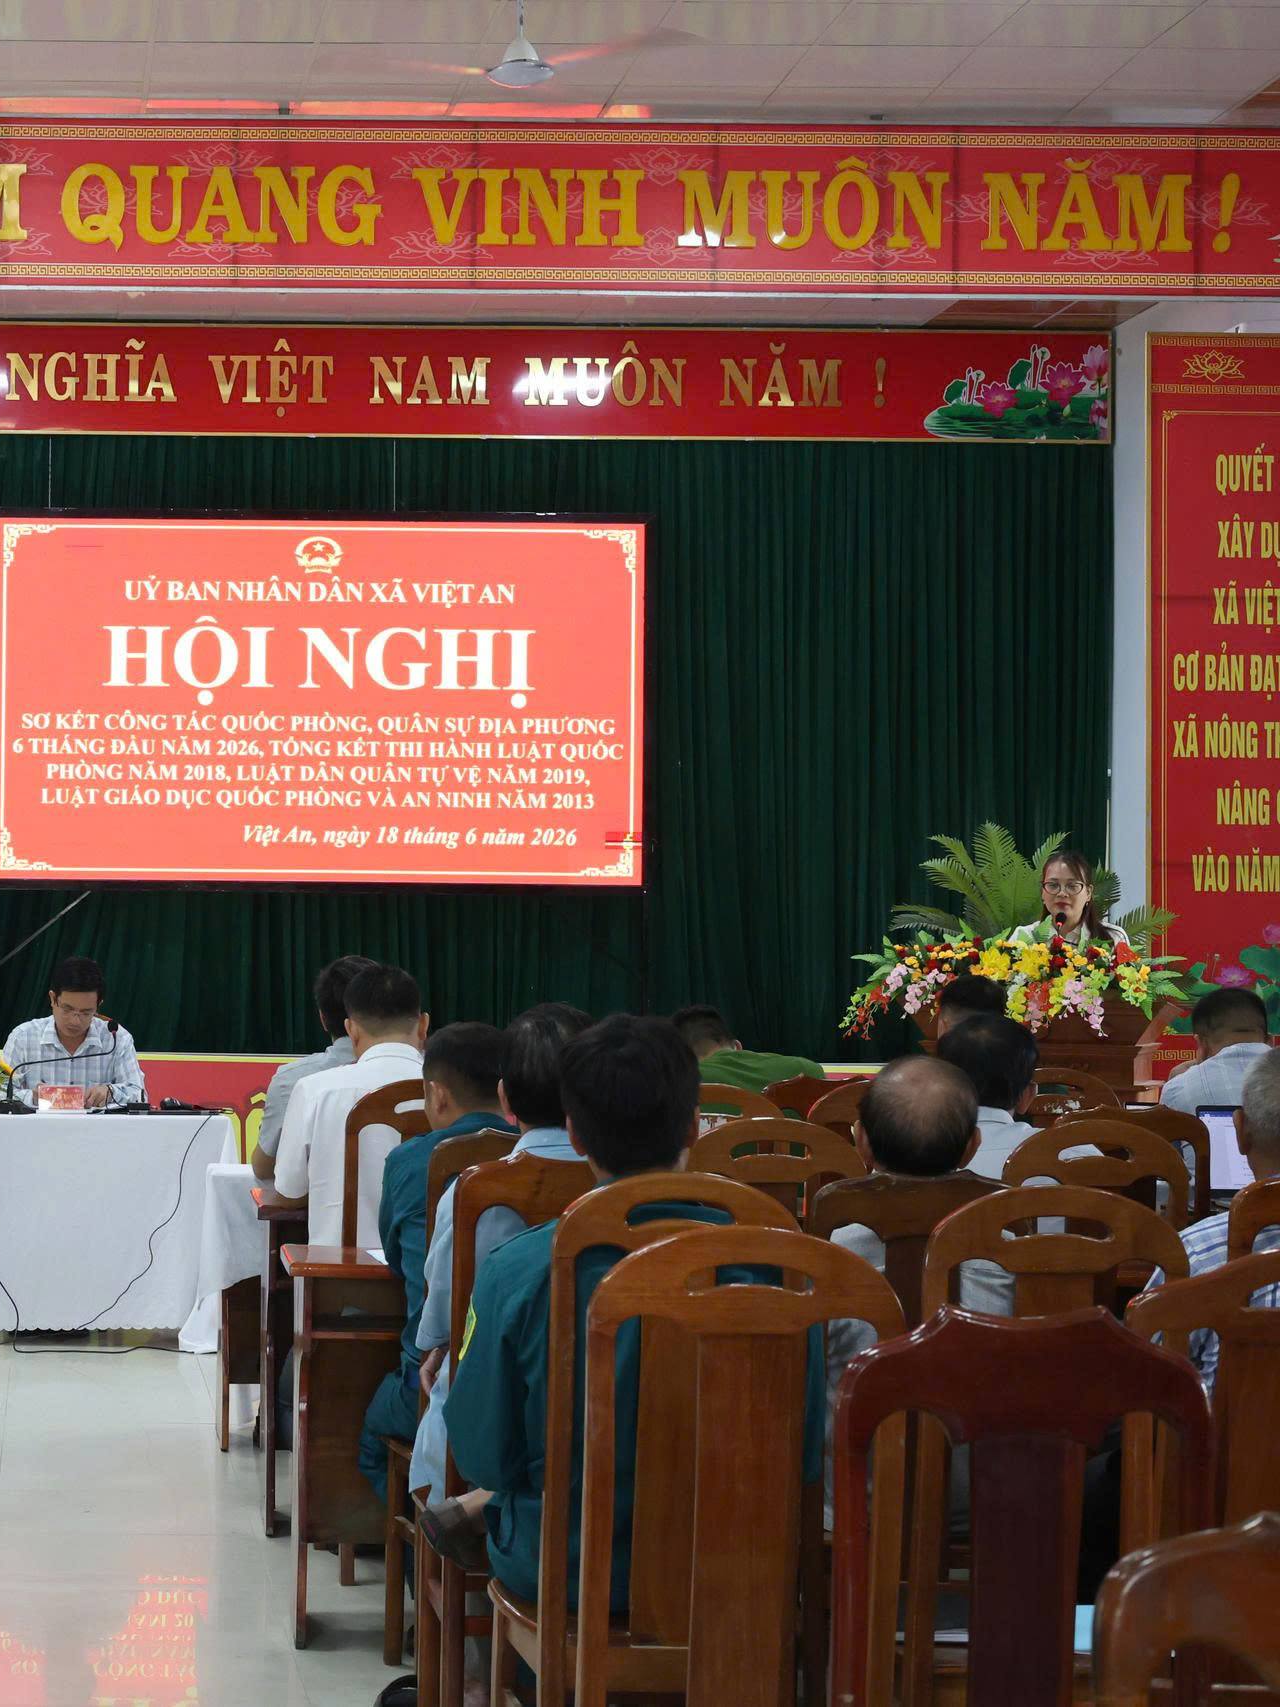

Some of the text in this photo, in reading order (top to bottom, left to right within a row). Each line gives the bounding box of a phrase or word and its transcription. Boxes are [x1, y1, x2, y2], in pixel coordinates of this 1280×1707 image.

[60, 164, 381, 252] QUANG
[411, 167, 645, 248] VINH
[677, 157, 948, 251] MUÔN
[981, 159, 1192, 254] NĂM
[4, 339, 177, 401] NGHĨA
[208, 339, 333, 417] VIỆT
[370, 357, 490, 404] NAM
[524, 341, 686, 408] MUÔN
[720, 343, 841, 407] NĂM
[1216, 443, 1274, 495] QUYẾT
[1218, 514, 1254, 558] XÂY
[124, 574, 515, 609] UỶ BAN NHÂN DÂN XÃ VIỆT AN
[1214, 581, 1239, 624] XÃ
[102, 615, 537, 709] HỘI NGHỊ
[1174, 651, 1199, 691] CƠ
[1205, 642, 1243, 691] BẢN
[21, 711, 51, 730] SƠ
[103, 709, 168, 731] CÔNG
[171, 710, 217, 731] TÁC
[290, 711, 373, 735] PHÒNG,
[377, 711, 440, 736] QUÂN
[444, 715, 476, 738] SỰ
[478, 717, 518, 738] ĐỊA
[521, 716, 616, 735] PHƯƠNG
[1173, 714, 1198, 757] XÃ
[1205, 713, 1258, 758] NÔNG
[12, 737, 24, 754] 6
[27, 734, 106, 755] THÁNG
[161, 735, 211, 756] NĂM
[216, 739, 265, 759] 2026,
[429, 737, 492, 759] HÀNH
[46, 758, 124, 781] PHÒNG
[128, 760, 178, 781] NĂM
[183, 764, 232, 784] 2018,
[299, 761, 345, 782] DÂN
[349, 761, 412, 786] QUÂN
[416, 764, 450, 787] TỰ
[452, 764, 482, 788] VỆ
[487, 763, 537, 784] NĂM
[542, 767, 591, 787] 2019,
[103, 784, 161, 806] GIÁO
[165, 789, 211, 810] DỤC
[284, 785, 362, 807] PHÒNG
[366, 787, 397, 808] VÀ
[400, 791, 431, 808] AN
[437, 791, 498, 809] NINH
[502, 788, 547, 809] NĂM
[552, 792, 595, 810] 2013
[1217, 780, 1269, 825] NÂNG
[243, 824, 577, 850] Việt An, ngày 18 tháng 6 năm 2026
[1192, 847, 1280, 892] VÀO NĂM
